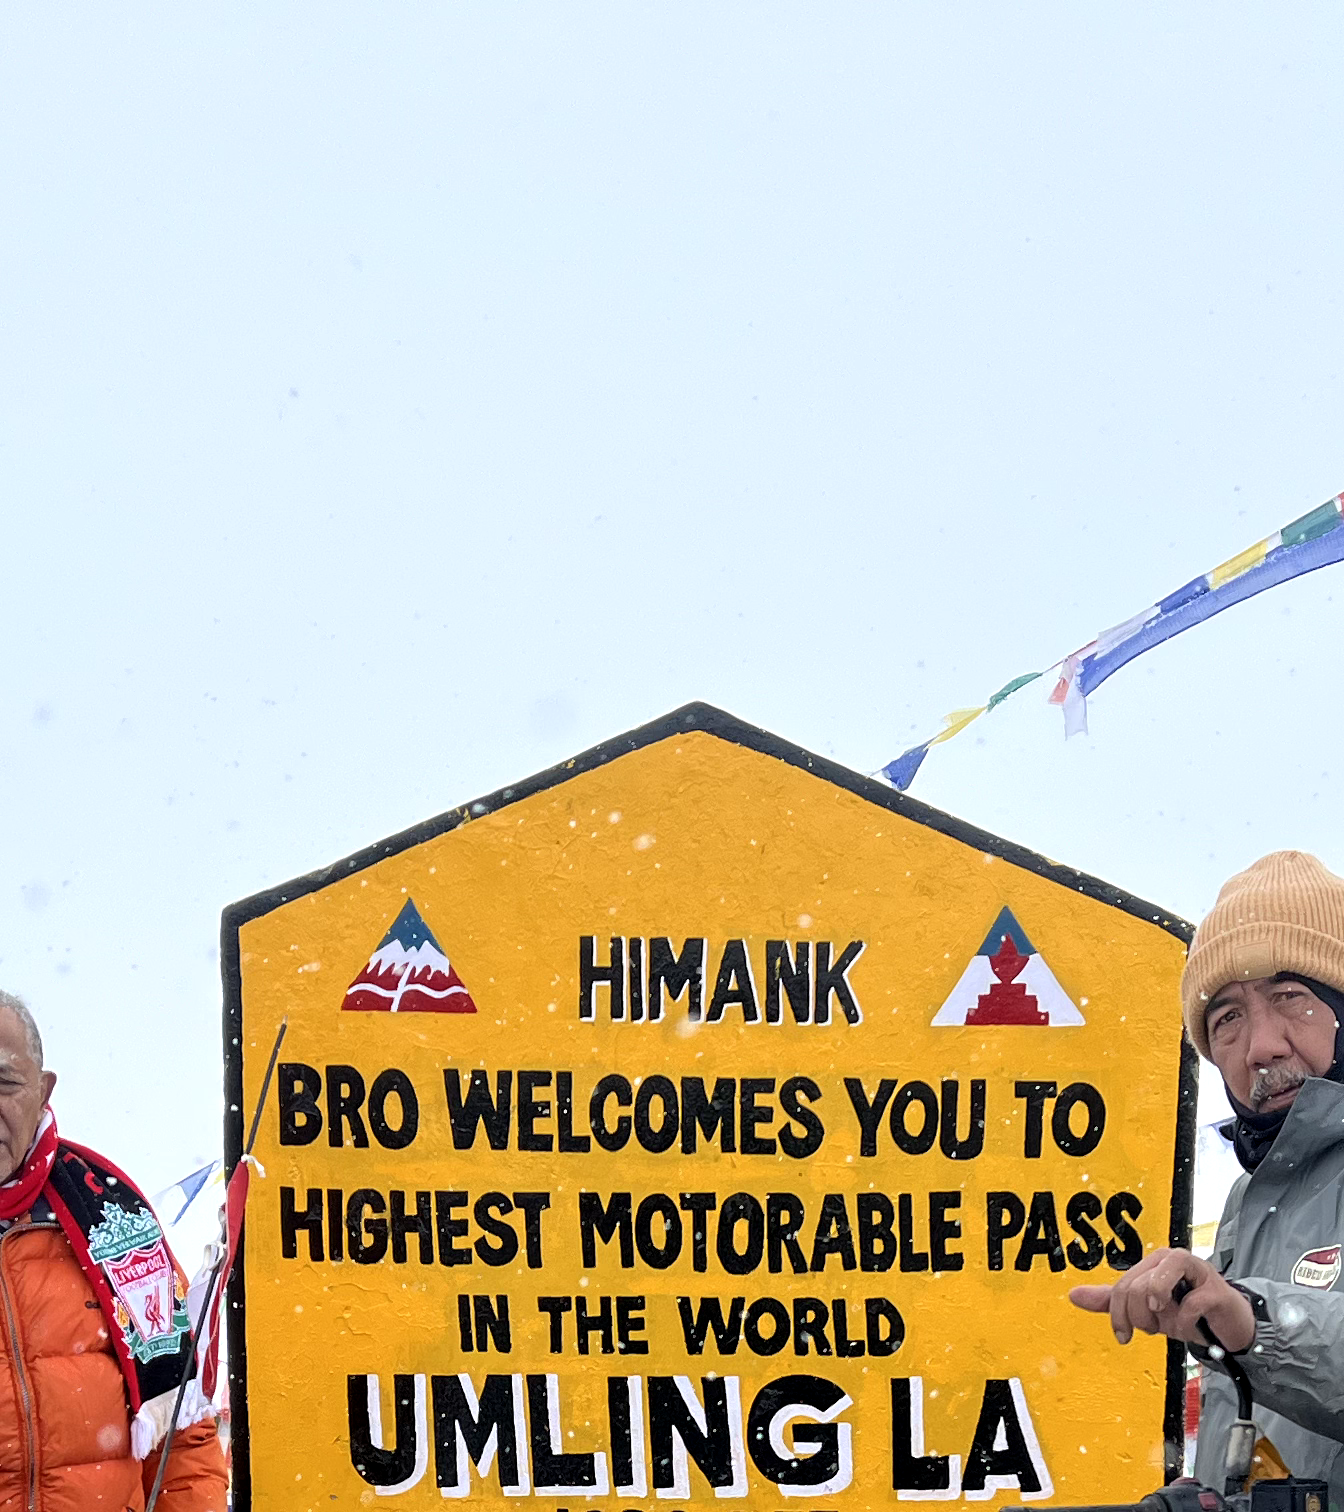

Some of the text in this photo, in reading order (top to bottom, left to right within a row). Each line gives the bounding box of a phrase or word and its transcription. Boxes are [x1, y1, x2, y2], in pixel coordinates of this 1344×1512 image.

[580, 936, 866, 1026] HIMANK
[278, 1063, 1105, 1160] BRO WELCOMES YOU TO
[114, 1254, 166, 1284] LIVERPOOL
[280, 1187, 1142, 1275] HIGHEST MOTORABLE PASS
[458, 1295, 904, 1358] IN THE WORLD
[348, 1374, 1054, 1500] UMLING LA
